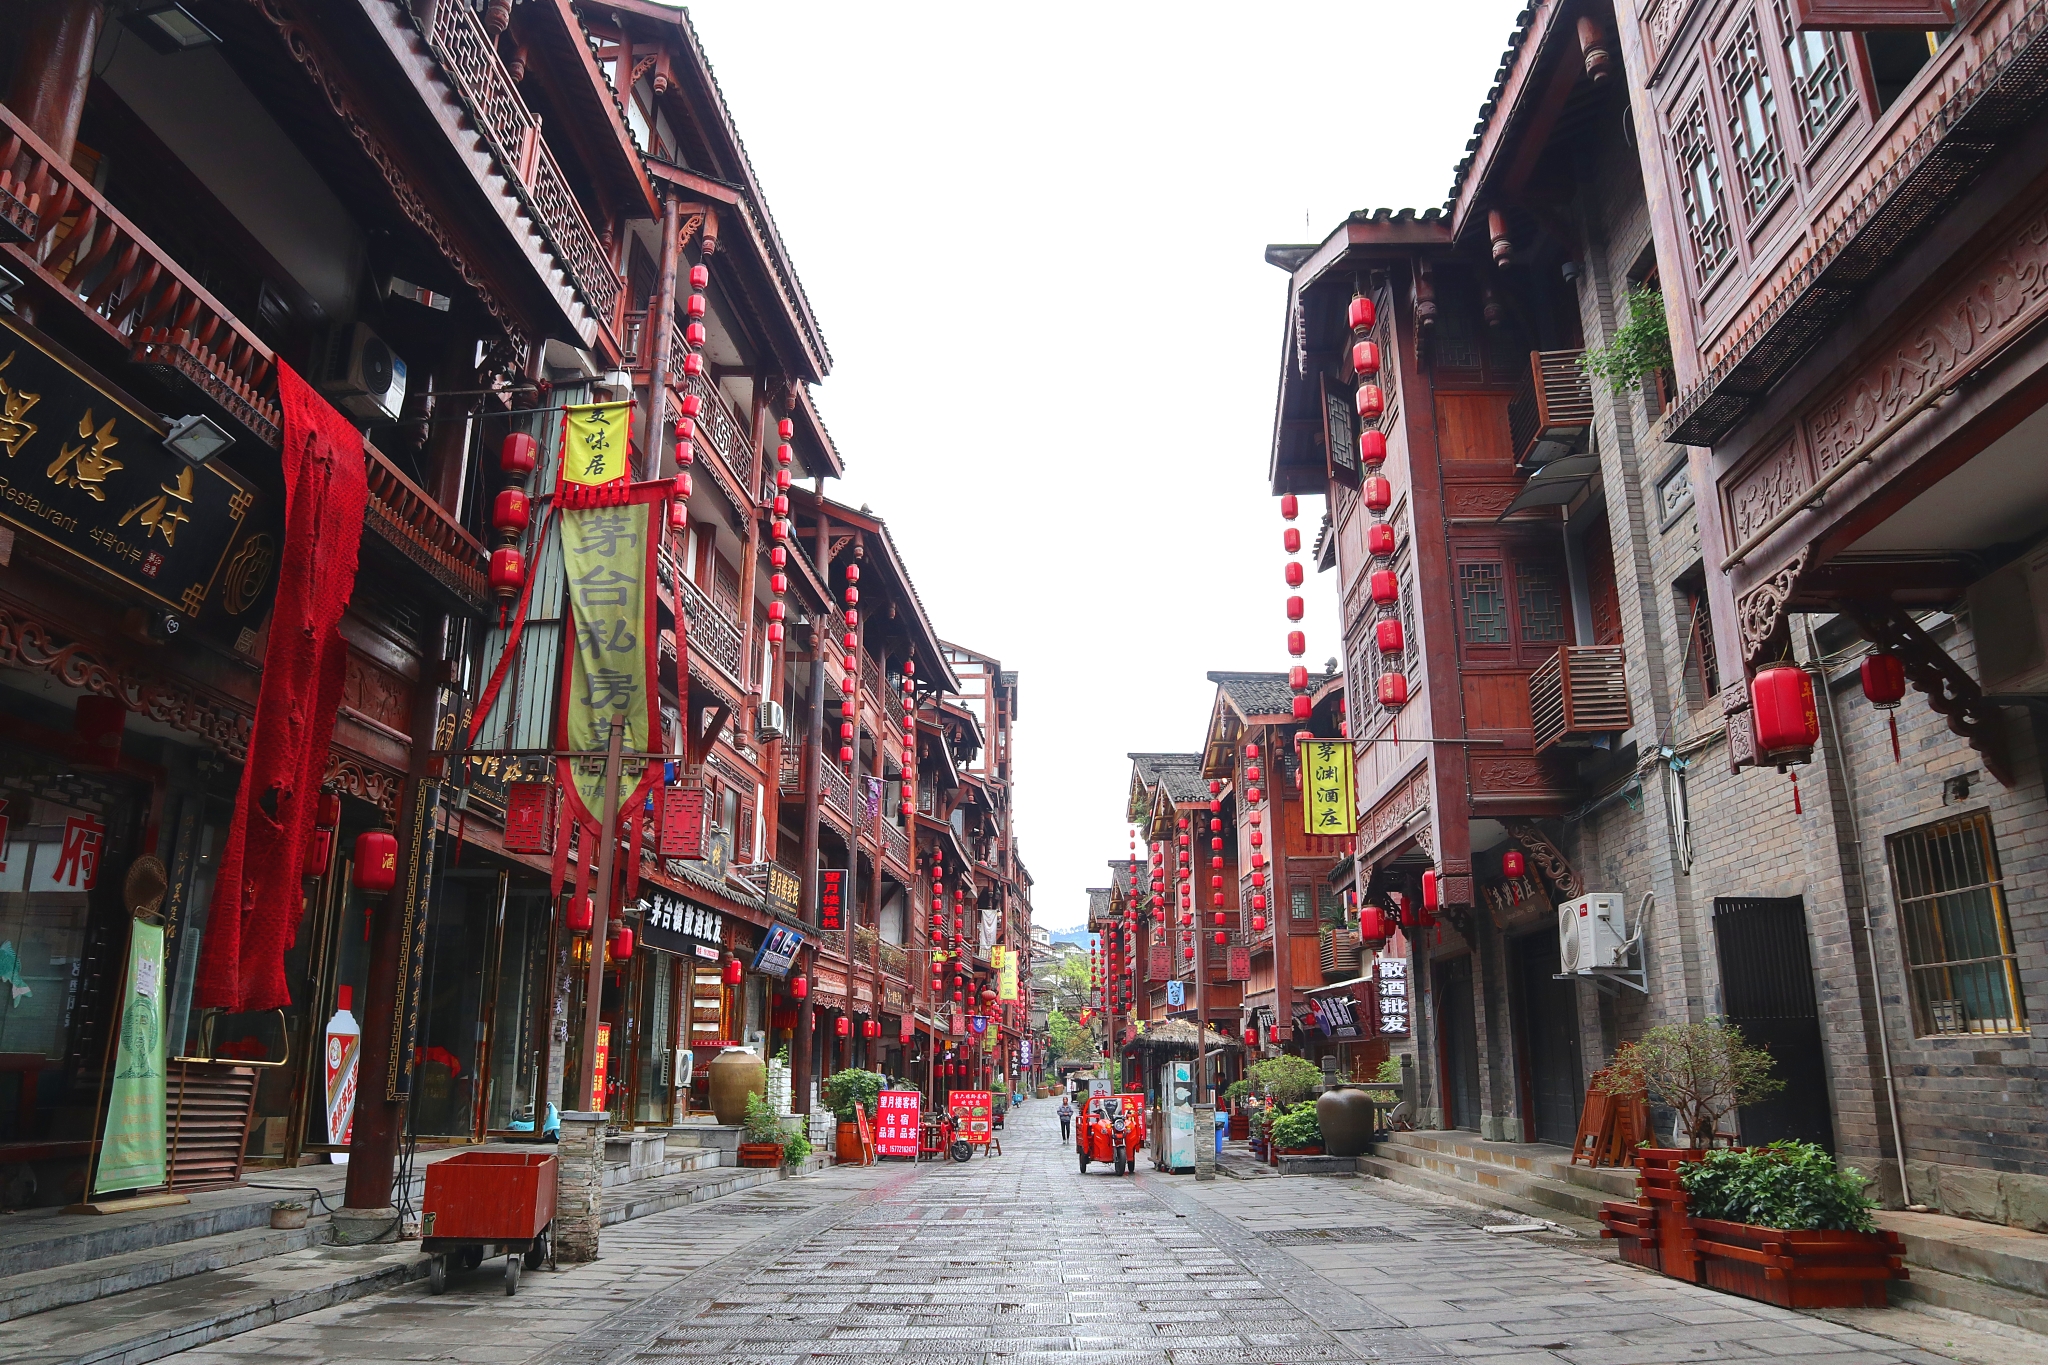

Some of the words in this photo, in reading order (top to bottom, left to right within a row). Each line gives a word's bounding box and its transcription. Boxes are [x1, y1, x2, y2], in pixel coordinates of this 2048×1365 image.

[0, 476, 78, 533] Restaurant
[572, 514, 639, 753] 茅台私房菜
[1801, 681, 1816, 735] 平等
[382, 853, 395, 871] 酒
[769, 868, 800, 906] 望月楼客栈
[650, 893, 723, 944] 茅台镇散酒批发
[822, 872, 841, 928] 望月楼客栈
[1379, 962, 1408, 1033] 散酒批发
[880, 1096, 918, 1109] 望月楼客栈
